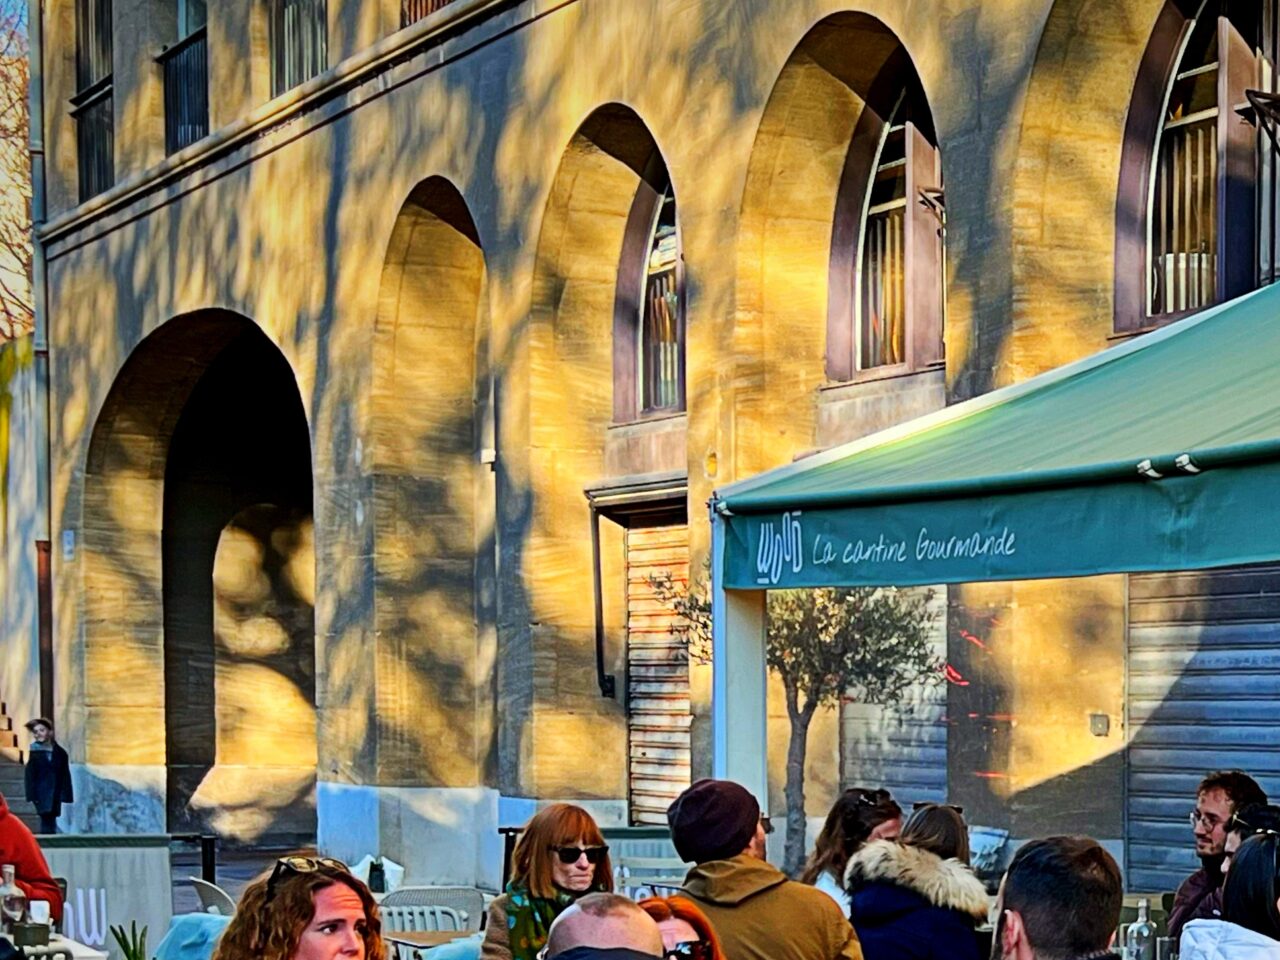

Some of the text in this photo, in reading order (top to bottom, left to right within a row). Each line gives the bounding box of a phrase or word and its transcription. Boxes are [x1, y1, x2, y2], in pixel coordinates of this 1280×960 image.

[756, 511, 803, 585] WOOD
[812, 527, 1016, 565] La cantine Gourmande
